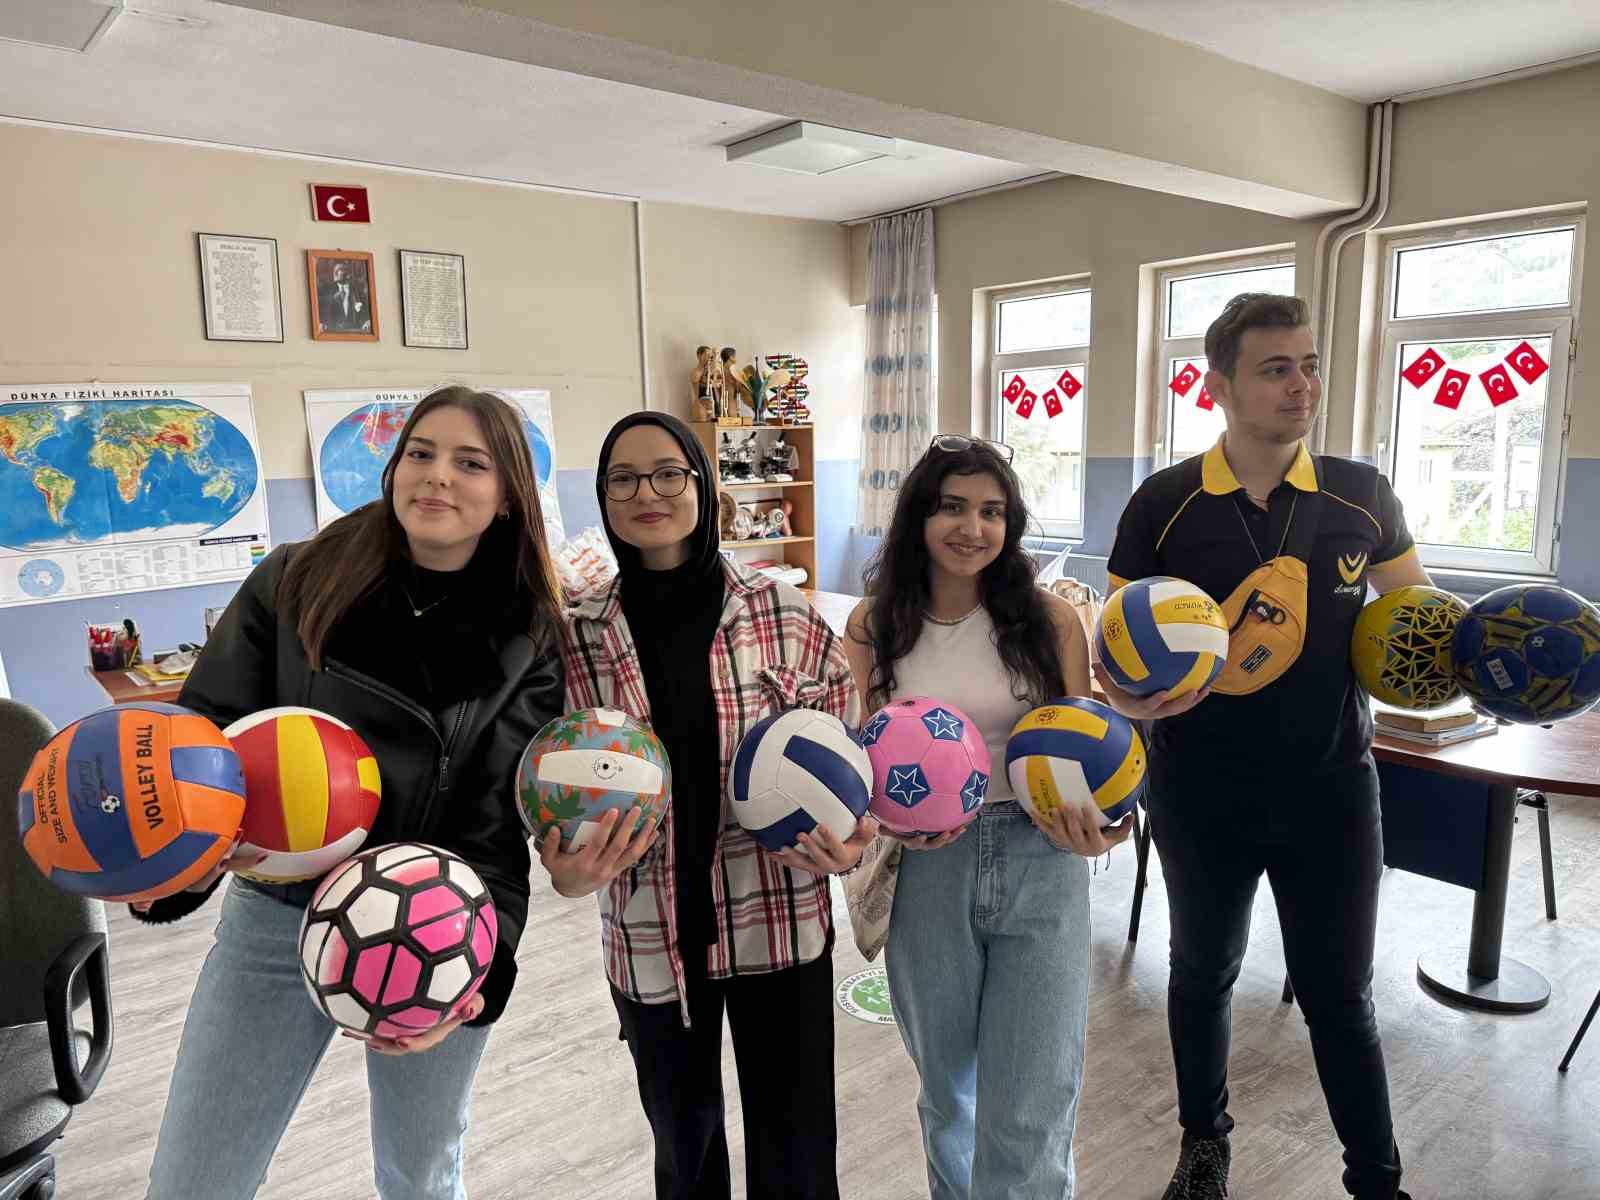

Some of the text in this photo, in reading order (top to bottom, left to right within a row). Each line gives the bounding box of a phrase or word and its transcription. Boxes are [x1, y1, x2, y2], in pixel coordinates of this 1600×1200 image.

[10, 389, 174, 401] DÜNYA FİZİKİ HARİTASI
[376, 392, 408, 400] DÜNYA
[36, 771, 48, 824] OFFICIAL
[46, 747, 68, 843] SIZE AND WEIGHT
[135, 724, 164, 830] VOLLEY BALL
